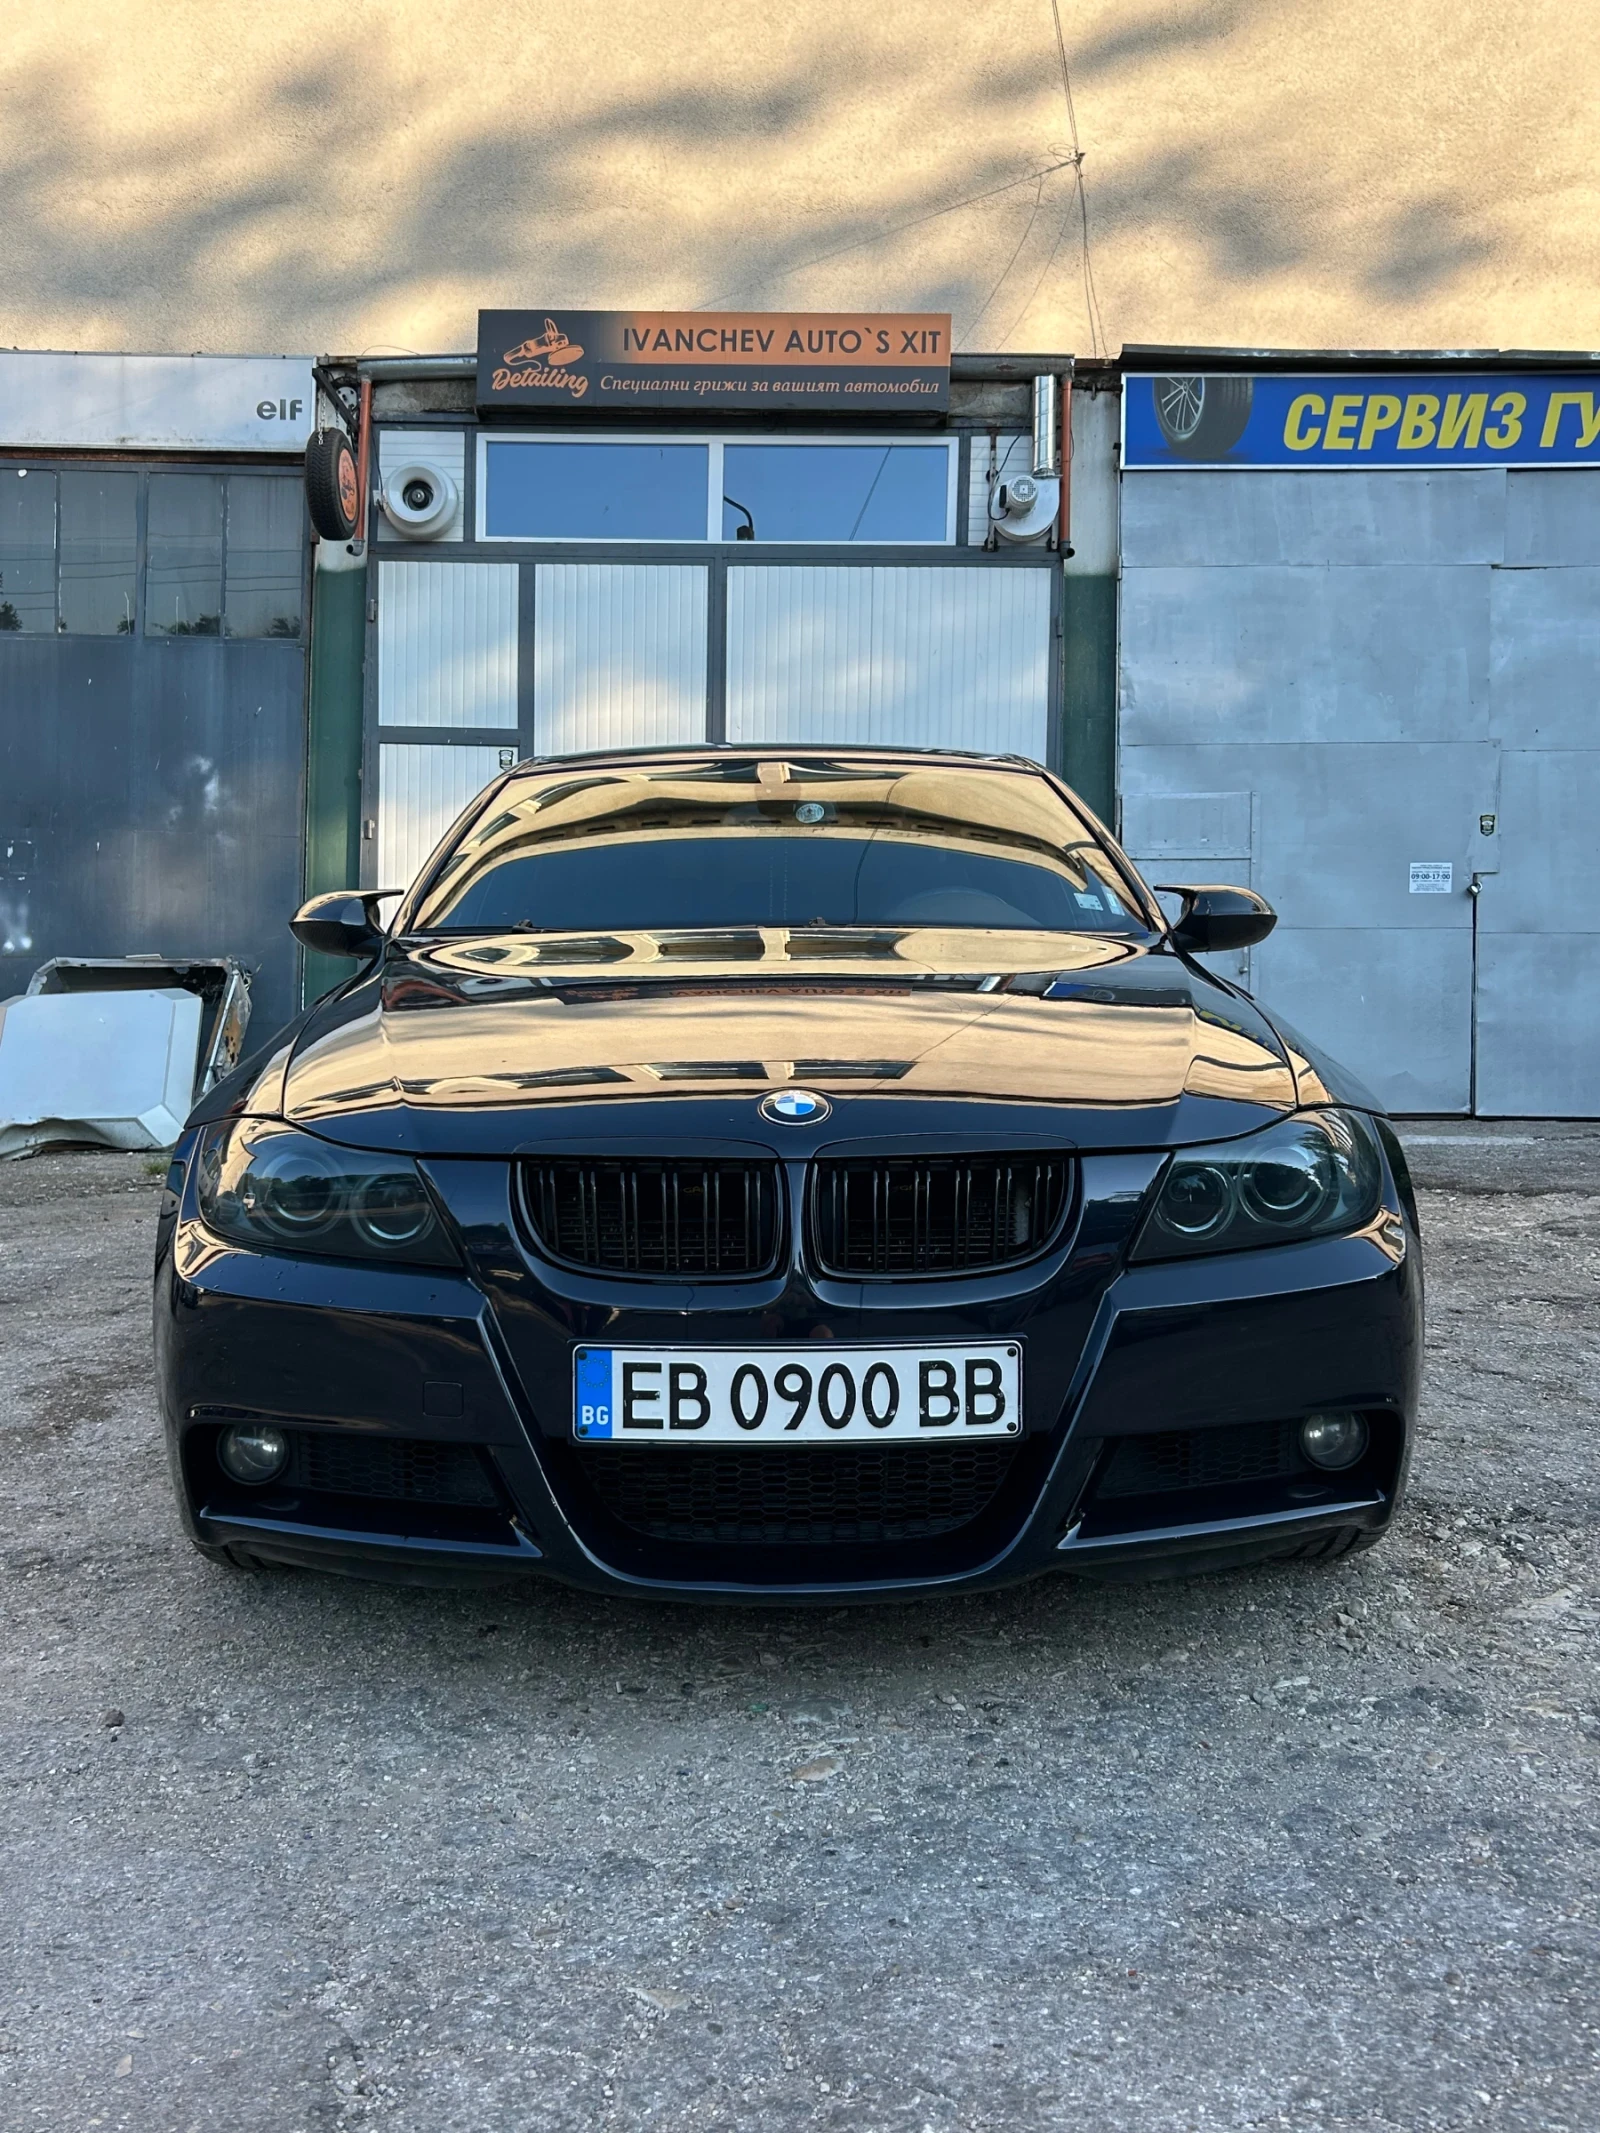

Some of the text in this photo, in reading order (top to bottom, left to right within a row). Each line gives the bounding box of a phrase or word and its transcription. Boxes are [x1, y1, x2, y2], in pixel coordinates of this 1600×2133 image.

[624, 328, 775, 352] IVANCHEV
[900, 330, 942, 354] XIT
[491, 367, 589, 397] Detailing
[600, 374, 939, 396] Специални грижи за вашият автомобил
[256, 399, 302, 420] elf
[1283, 392, 1527, 451] СЕРВИЗ
[622, 1358, 1006, 1430] EB 0900 BB
[581, 1404, 609, 1425] BG
